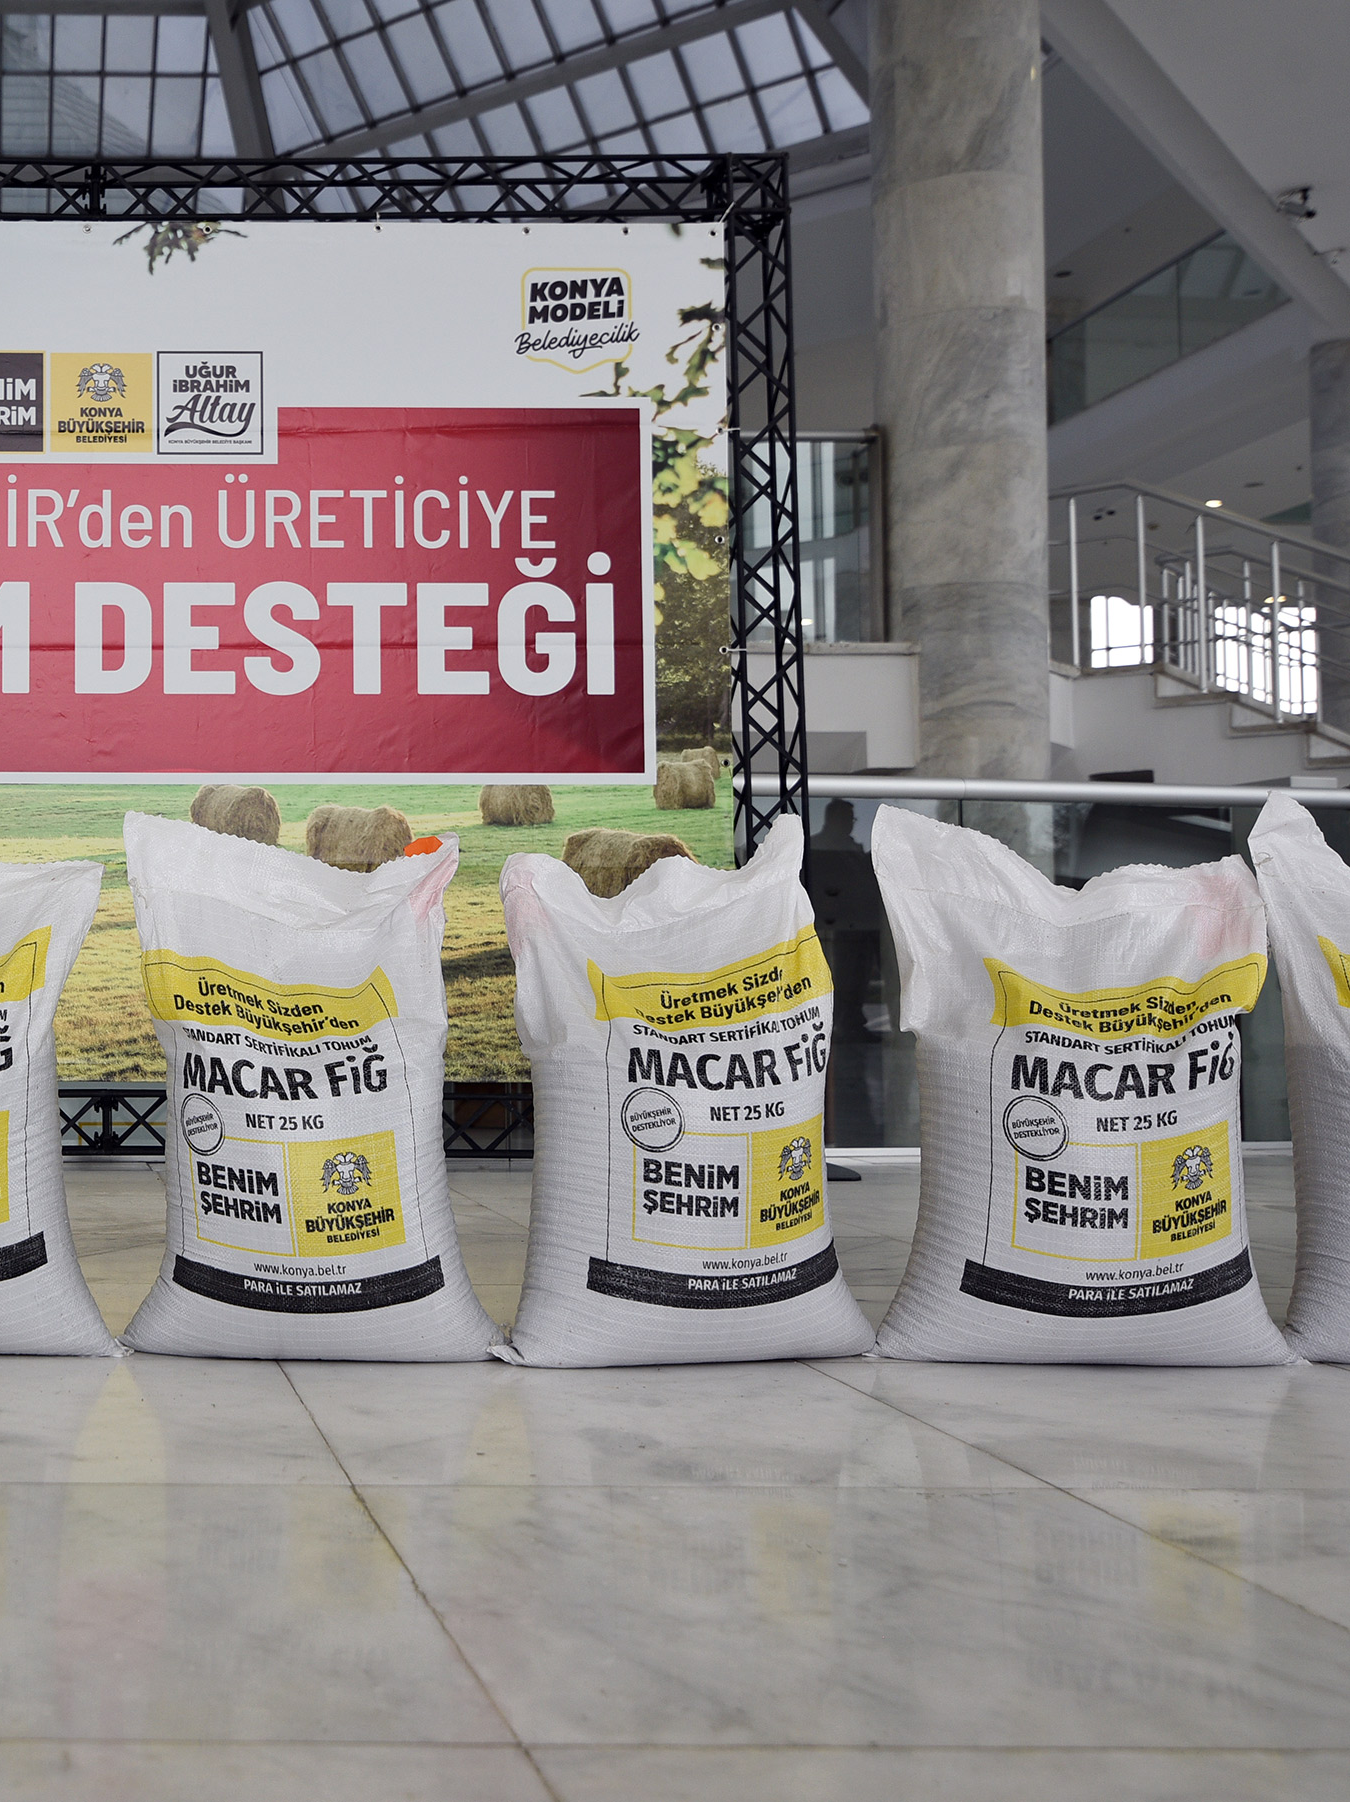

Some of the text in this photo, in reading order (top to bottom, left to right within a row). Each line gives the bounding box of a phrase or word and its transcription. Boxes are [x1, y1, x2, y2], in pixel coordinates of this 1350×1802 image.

[530, 277, 624, 302] KONYA
[515, 322, 640, 359] Belediyecilik
[185, 361, 237, 378] UĞUR
[80, 407, 123, 418] KONYA
[164, 394, 256, 437] Altay
[57, 419, 145, 436] BÜYÜKŞEHİR
[76, 433, 127, 443] BELEDİYESİ
[217, 473, 557, 549] ÜRETİCİYE
[74, 551, 616, 697] DESTEĞİ
[174, 994, 232, 1016] Destek
[198, 977, 324, 1017] Üretmek Sizden
[660, 982, 739, 1010] Üretmek
[1029, 1000, 1093, 1032] Destek
[1059, 1002, 1140, 1019] Üretmek
[325, 1035, 372, 1052] TOHUM
[632, 1024, 706, 1044] STANDART
[1025, 1031, 1100, 1052] STANDART
[183, 1052, 318, 1100] MACAR
[628, 1047, 780, 1091] MACAR
[1011, 1054, 1176, 1101] MACAR
[246, 1113, 324, 1130] NET 25 KG
[630, 1106, 672, 1122] BÜYÜKŞEHİR
[710, 1101, 785, 1122] NET 25 KG
[1096, 1110, 1178, 1132] NET 25 KG
[632, 1117, 677, 1133] DESTEKLİYOR
[1012, 1116, 1056, 1129] BÜYÜKŞEHİR
[1014, 1127, 1060, 1139] DESTEKLİYOR
[780, 1181, 810, 1201] KONYA
[1174, 1191, 1212, 1211] KONYA
[328, 1198, 372, 1214] KONYA
[760, 1190, 820, 1223] BÜYÜKŞEHİR
[306, 1208, 394, 1233] BÜYÜKŞEHİR
[1152, 1200, 1227, 1234] BÜYÜKŞEHİR
[327, 1228, 380, 1243] BELEDİYESİ
[1170, 1220, 1216, 1242] BELEDİYESİ
[254, 1261, 346, 1277] www.konya.bel.tr
[702, 1252, 788, 1270] www.konya.bel.tr
[688, 1277, 719, 1290] PARA
[742, 1268, 797, 1289] SATILAMAZ
[1086, 1263, 1184, 1281] www.konya.bel.tr
[244, 1279, 273, 1294] PARA
[296, 1280, 362, 1296] SATILAMAZ
[1068, 1286, 1102, 1300] PARA
[1128, 1278, 1194, 1300] SATILAMAZ
